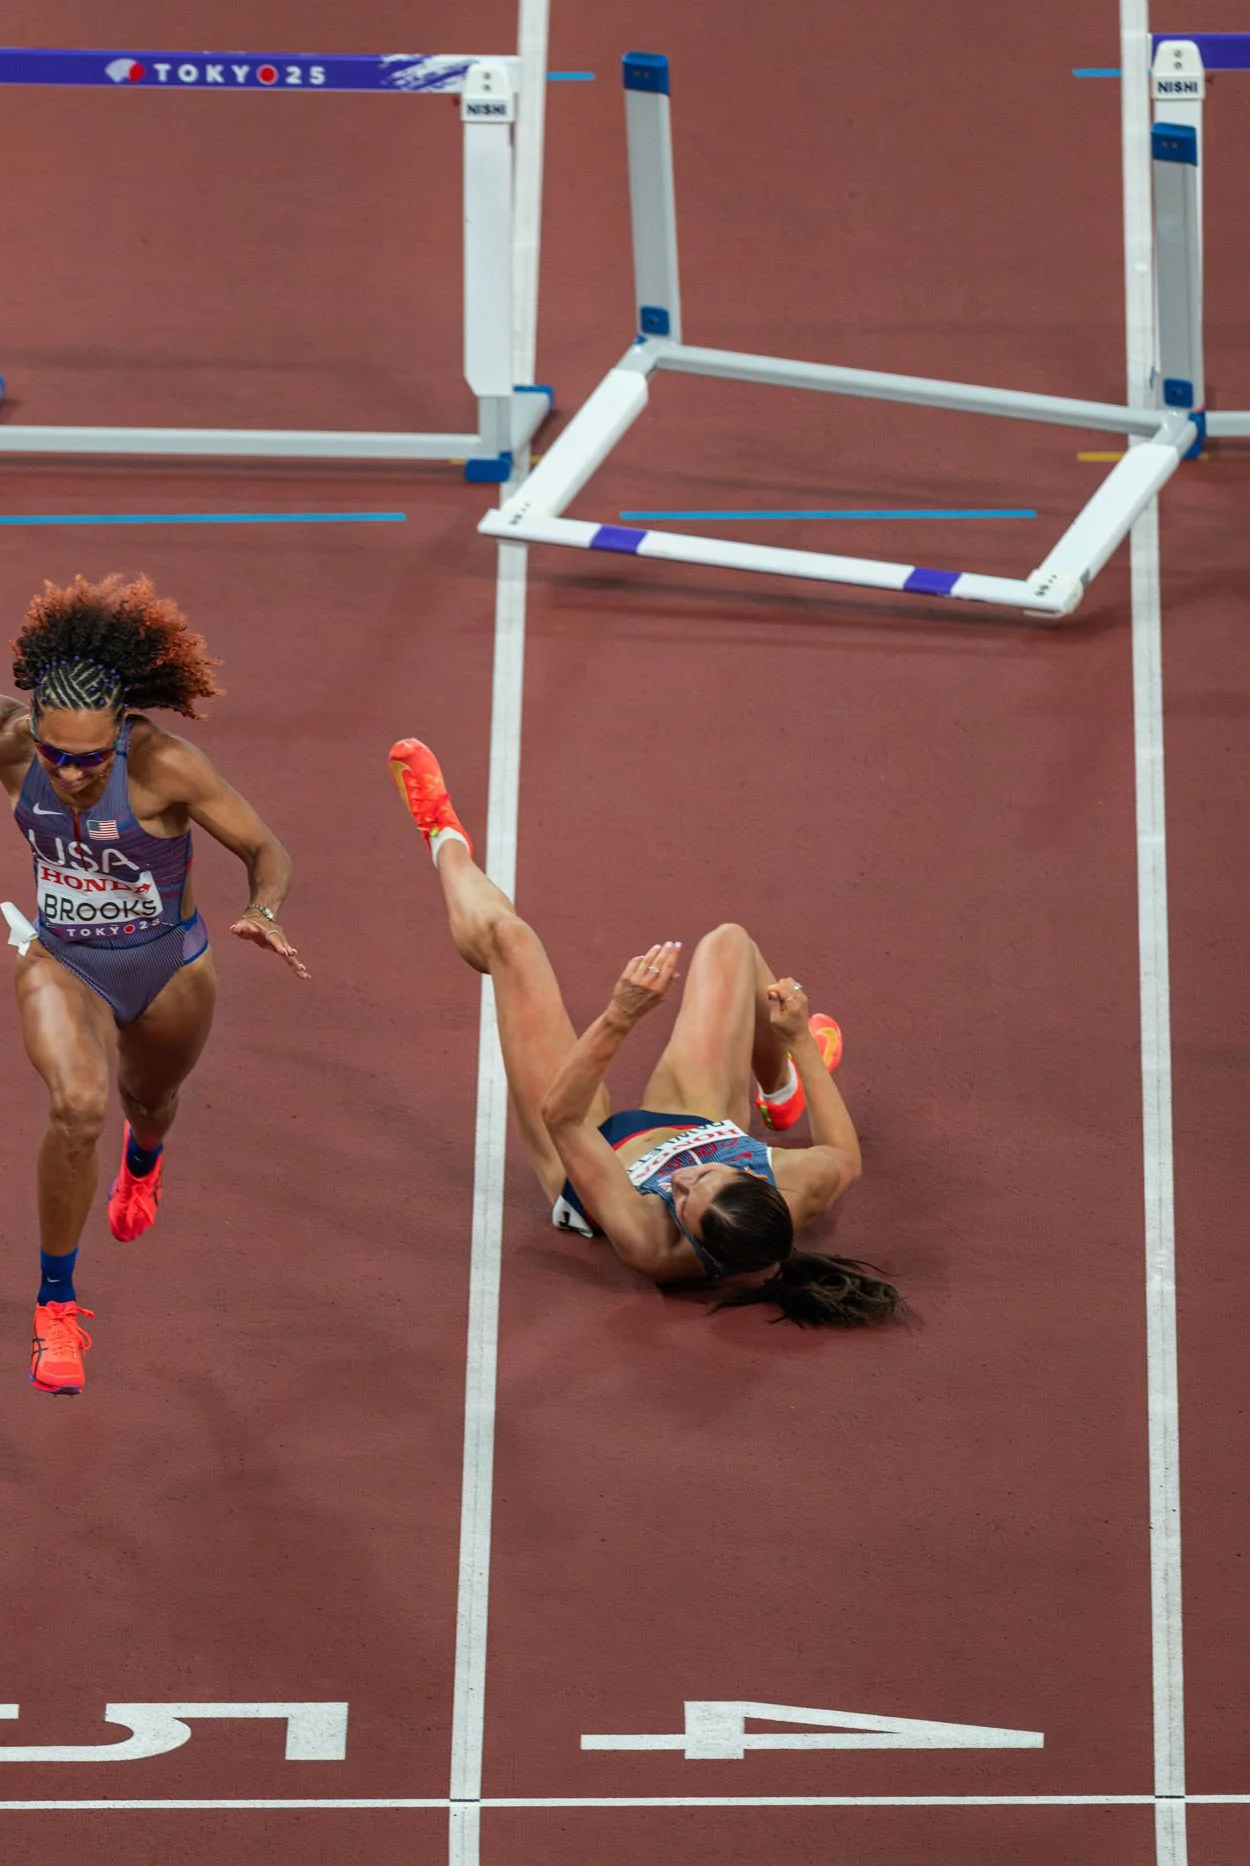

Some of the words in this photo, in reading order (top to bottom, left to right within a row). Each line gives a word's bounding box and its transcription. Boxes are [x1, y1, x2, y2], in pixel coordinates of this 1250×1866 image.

[1157, 81, 1198, 93] NISHI
[467, 104, 507, 115] NISHI
[27, 828, 140, 874] USA
[40, 865, 152, 893] HONDA
[44, 892, 157, 923] BROOKS
[580, 1700, 1045, 1760] 4
